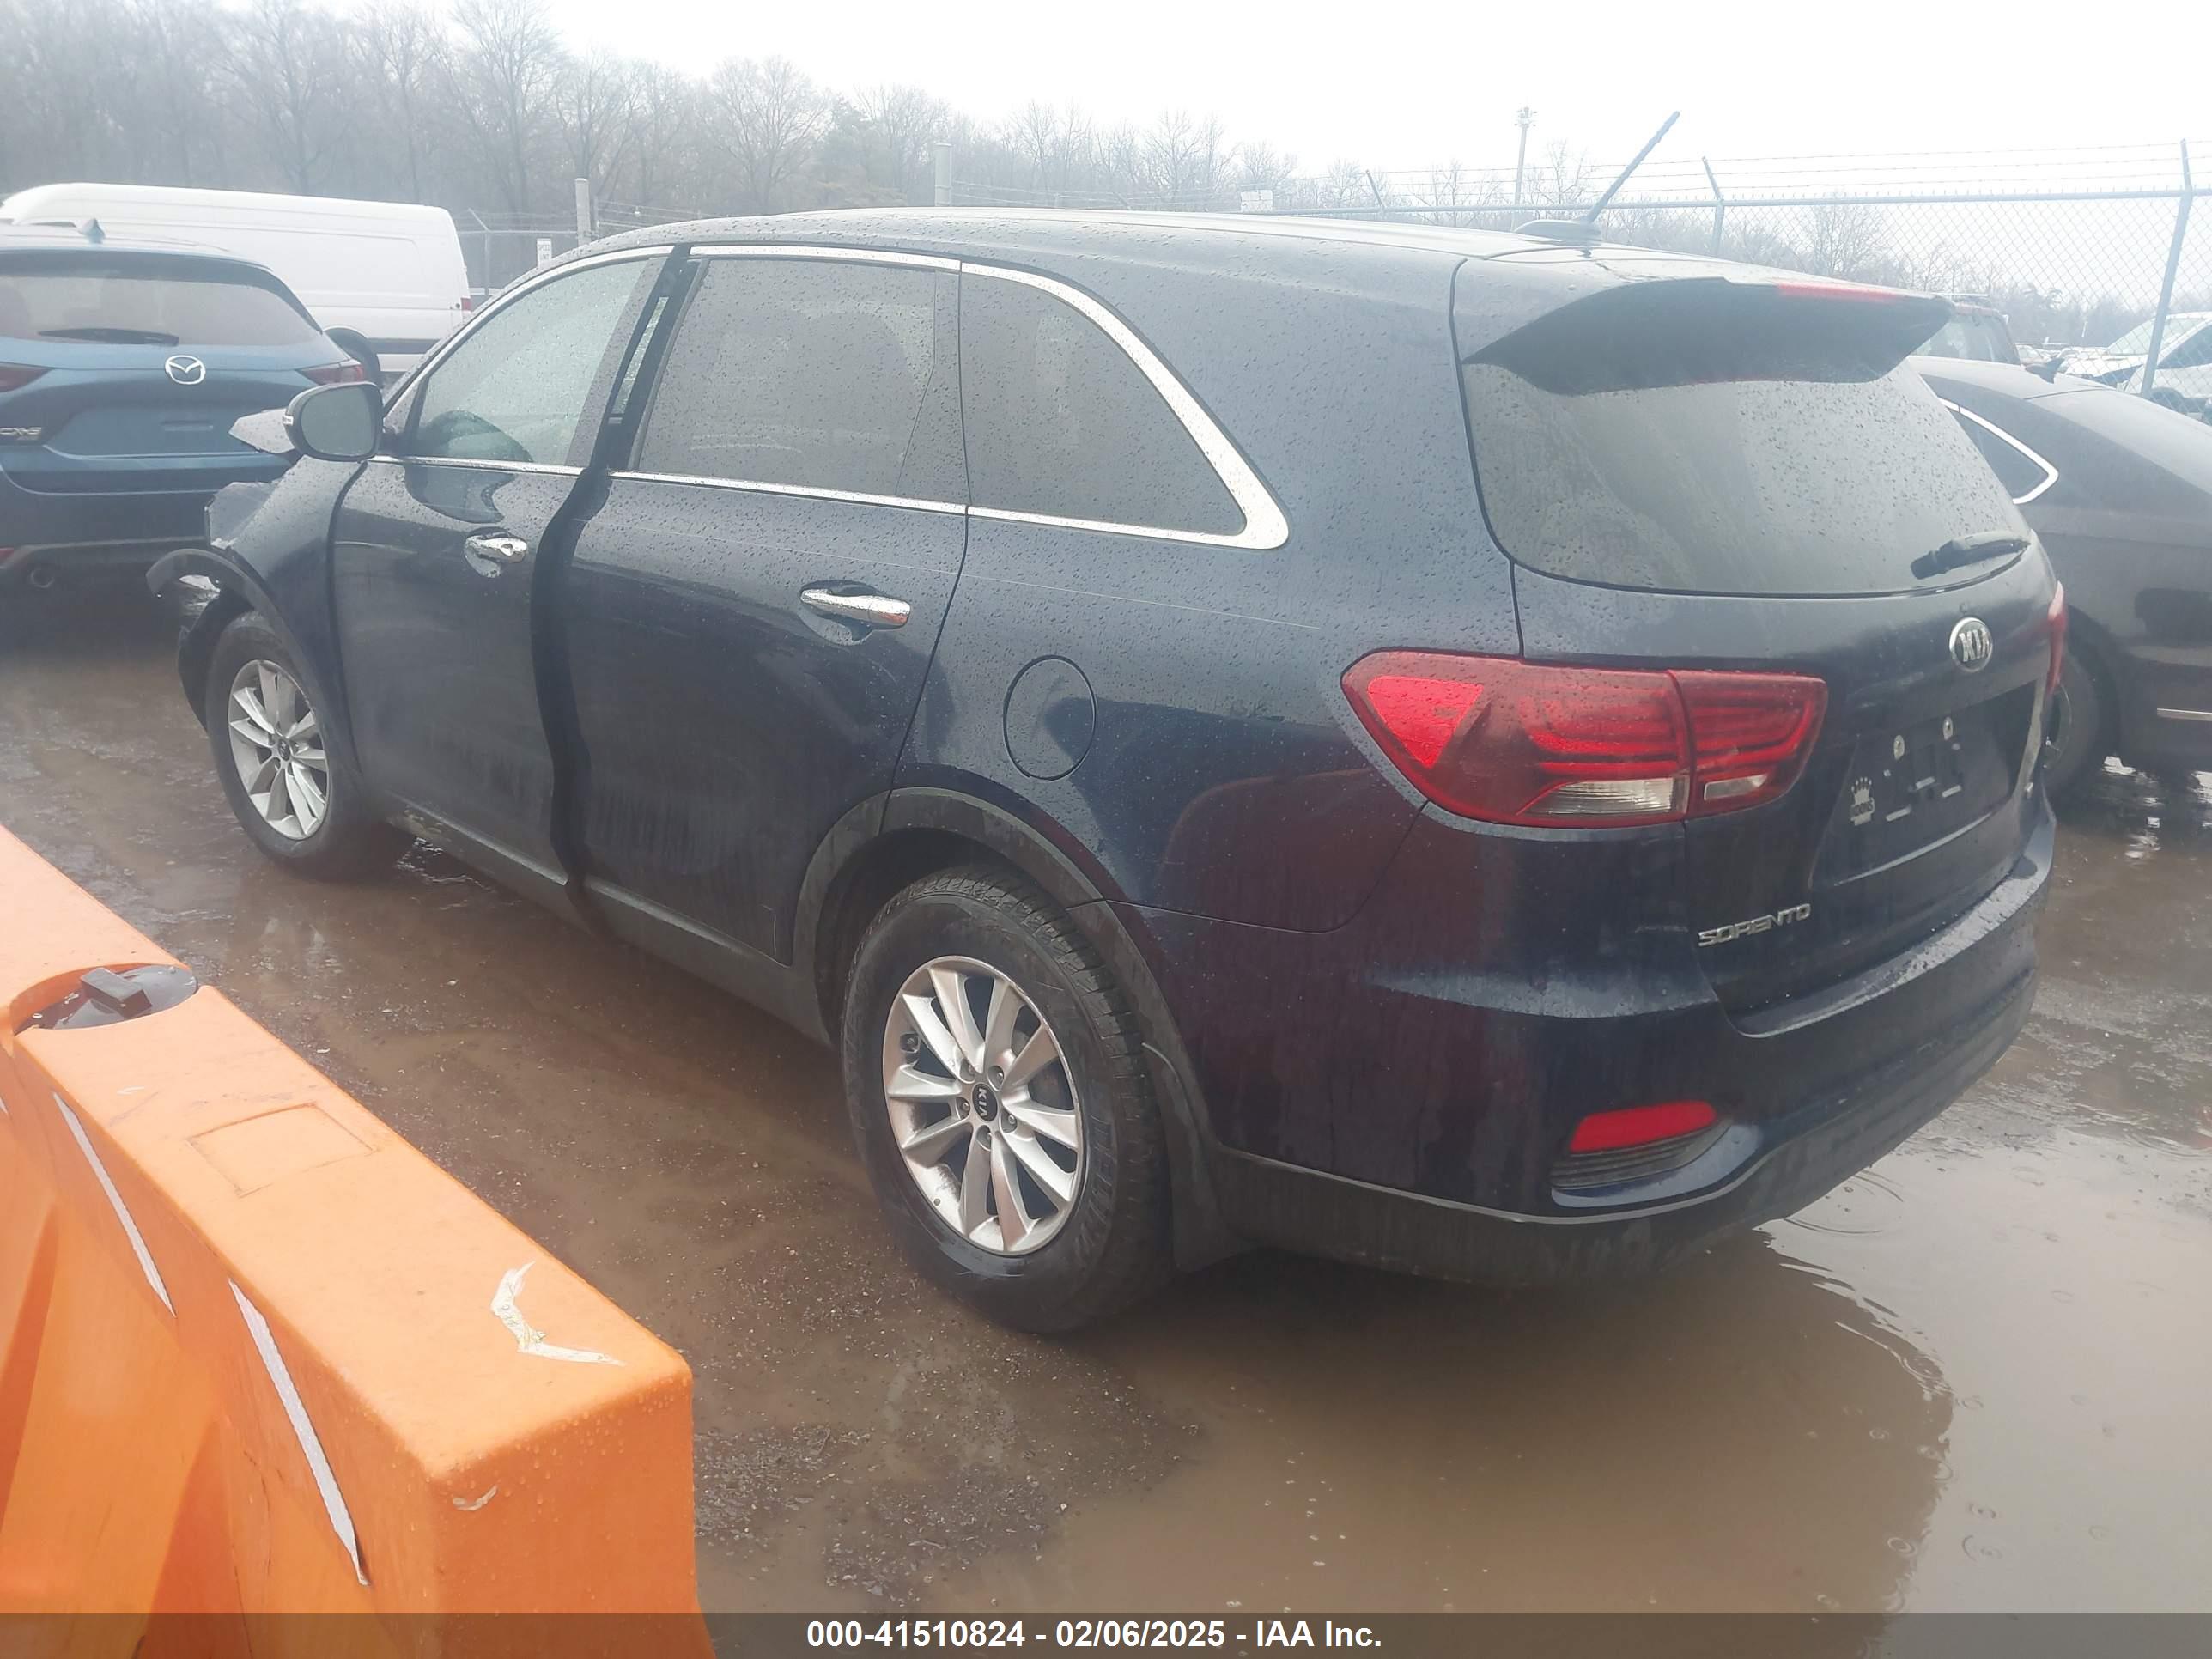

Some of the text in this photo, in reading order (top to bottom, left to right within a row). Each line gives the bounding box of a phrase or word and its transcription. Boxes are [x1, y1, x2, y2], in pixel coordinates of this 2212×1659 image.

[1959, 629, 1991, 663] KIA
[1698, 903, 1811, 947] SORENTO
[978, 1087, 988, 1116] KIA
